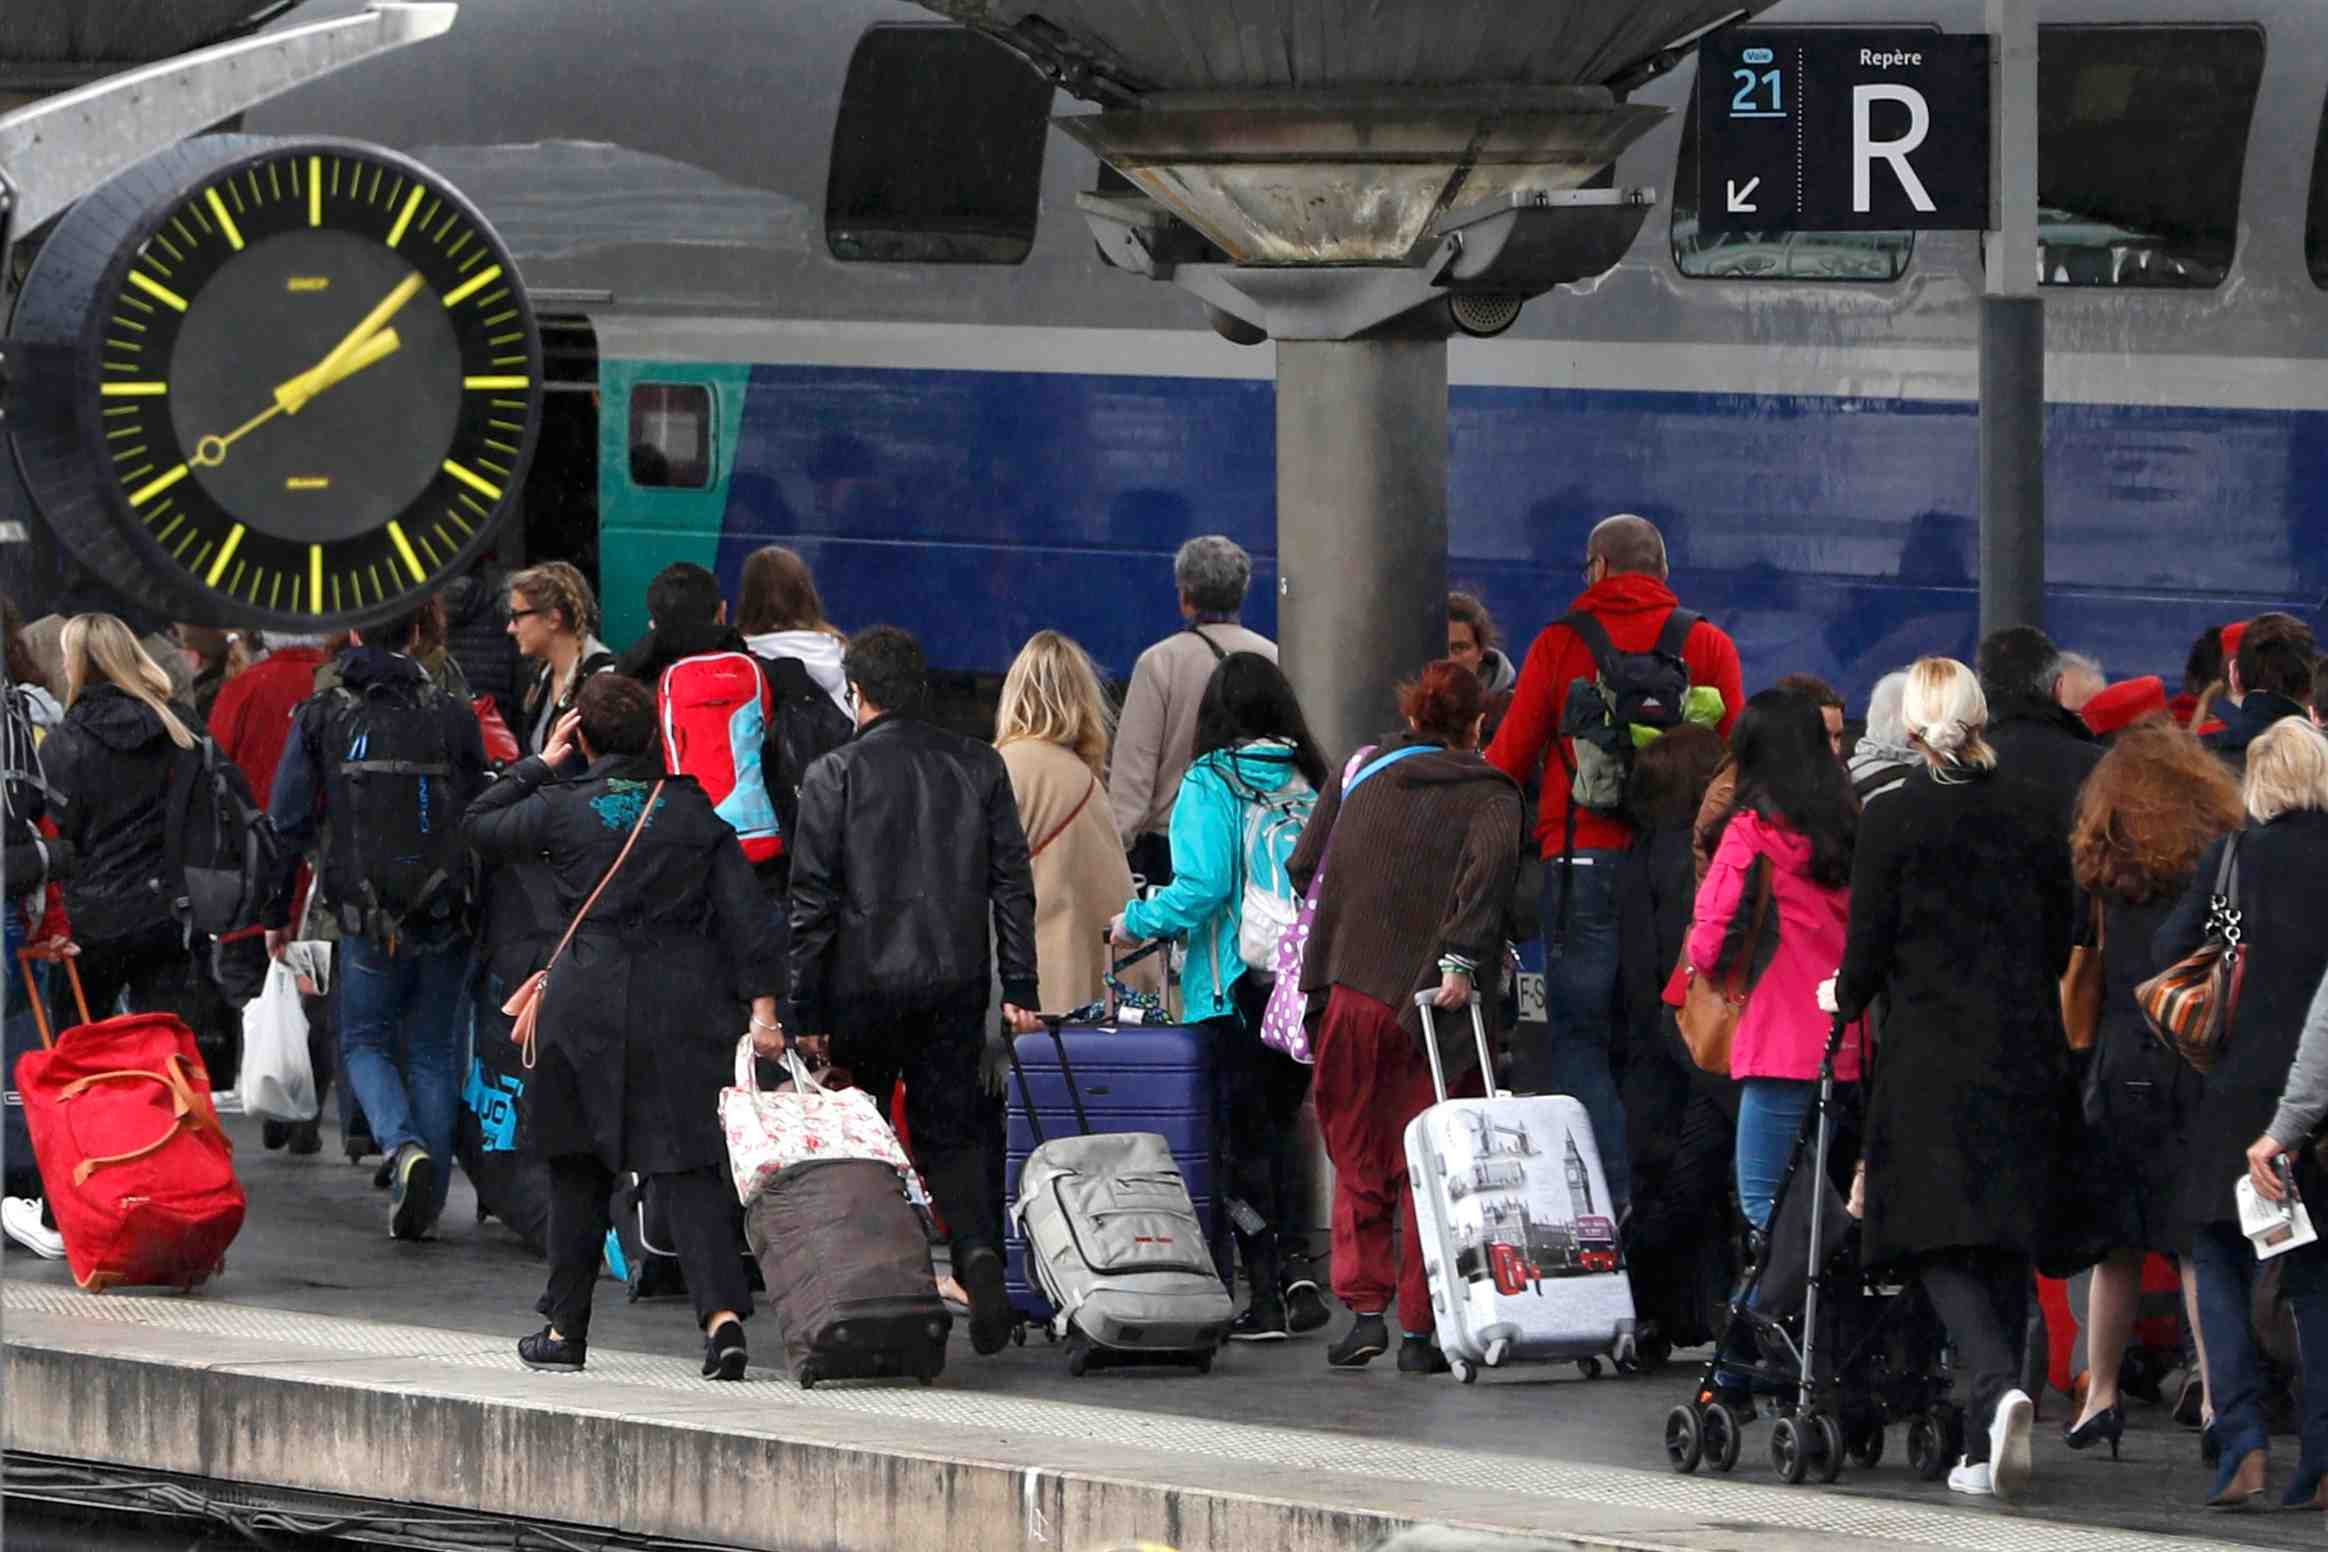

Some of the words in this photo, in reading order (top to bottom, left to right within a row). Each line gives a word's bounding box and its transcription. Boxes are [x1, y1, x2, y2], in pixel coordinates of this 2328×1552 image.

[1860, 48, 1922, 69] Repère
[1731, 69, 1782, 110] 21
[1853, 83, 1937, 212] R
